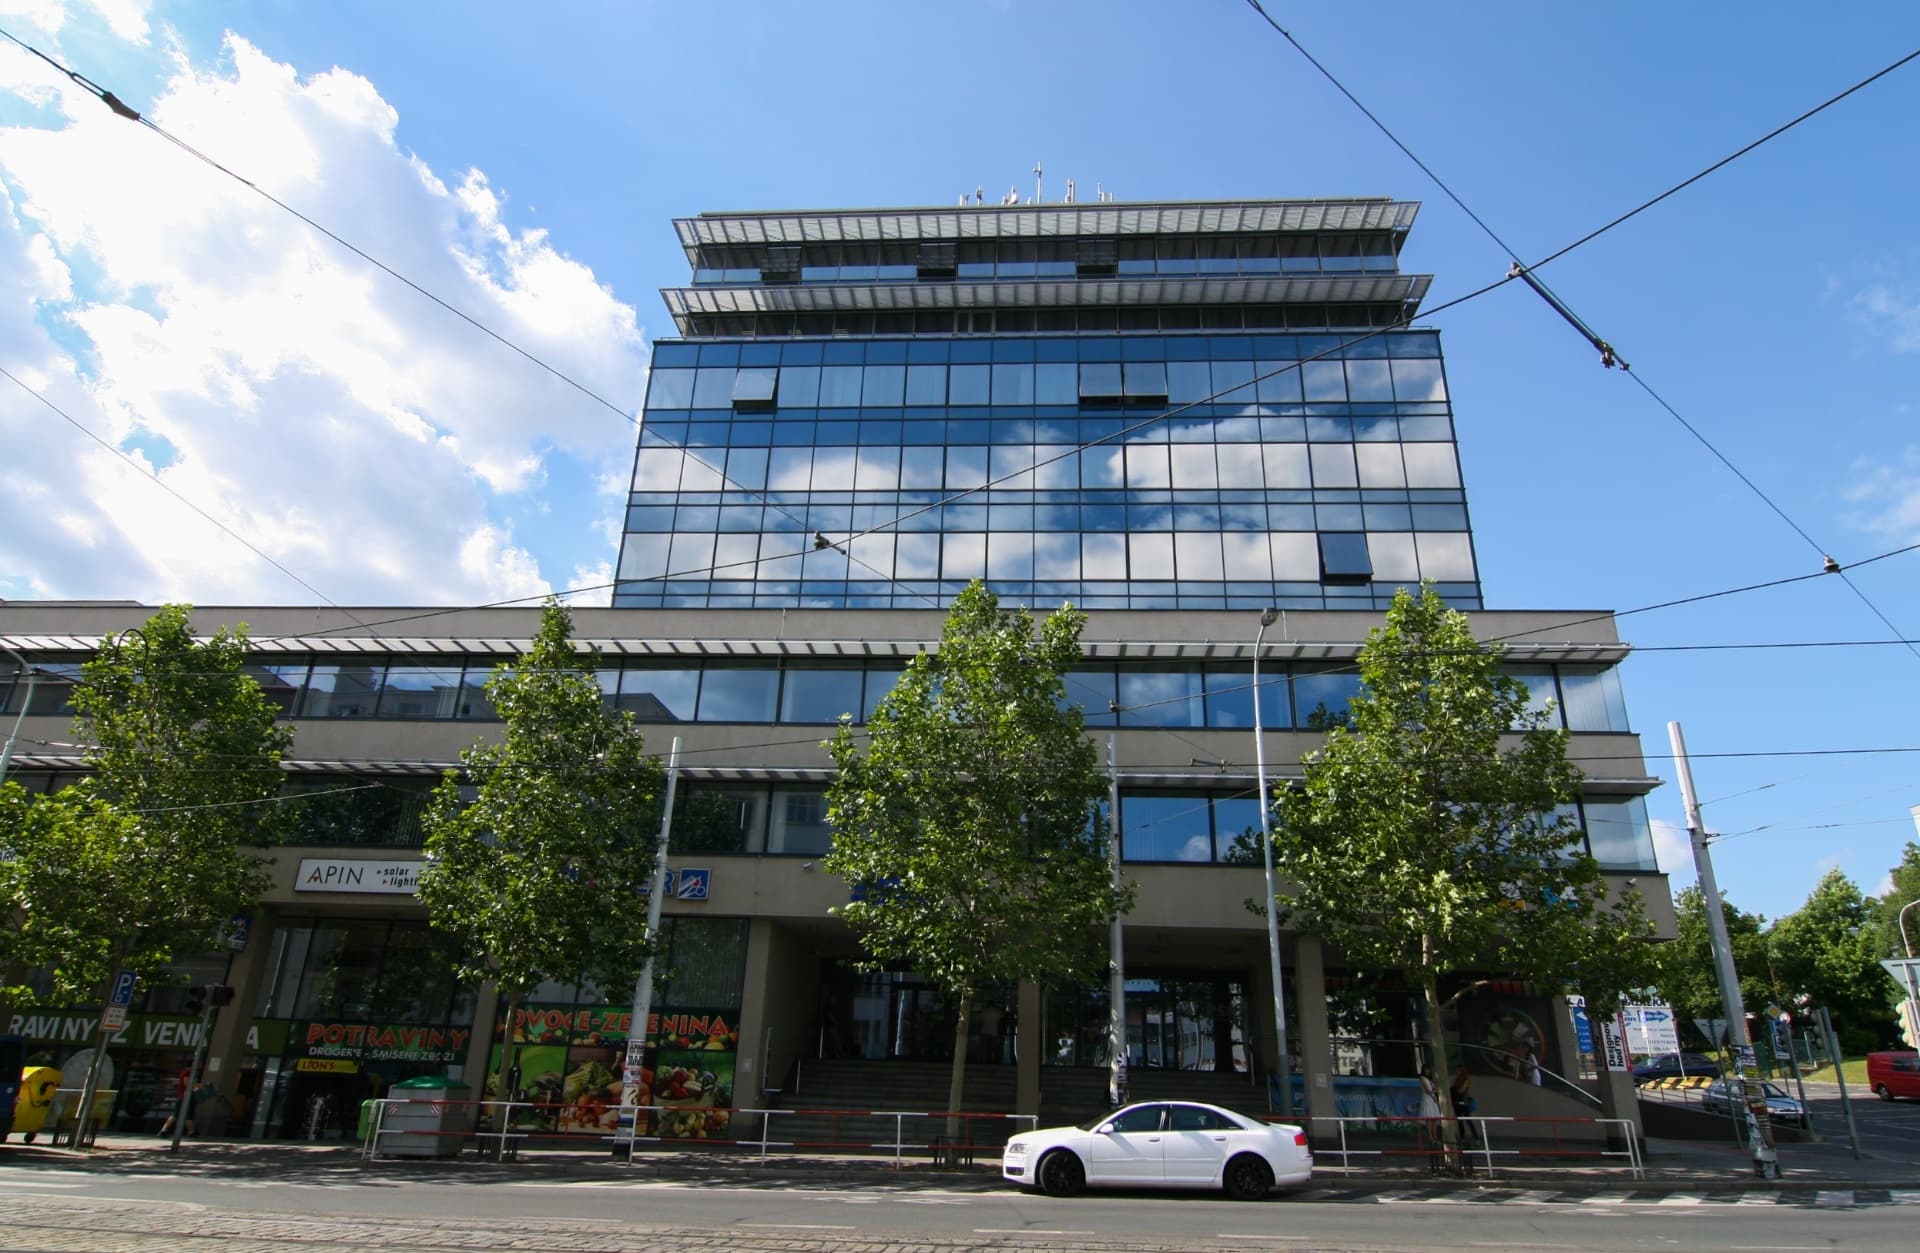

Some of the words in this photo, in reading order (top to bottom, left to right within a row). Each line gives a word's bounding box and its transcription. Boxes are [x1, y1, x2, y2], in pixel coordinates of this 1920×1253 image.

[306, 866, 364, 884] APIN
[383, 866, 410, 876] solar
[390, 876, 418, 888] lighti
[117, 973, 132, 995] P
[306, 1023, 470, 1049] POTRAVINY
[1602, 1022, 1616, 1067] Designov
